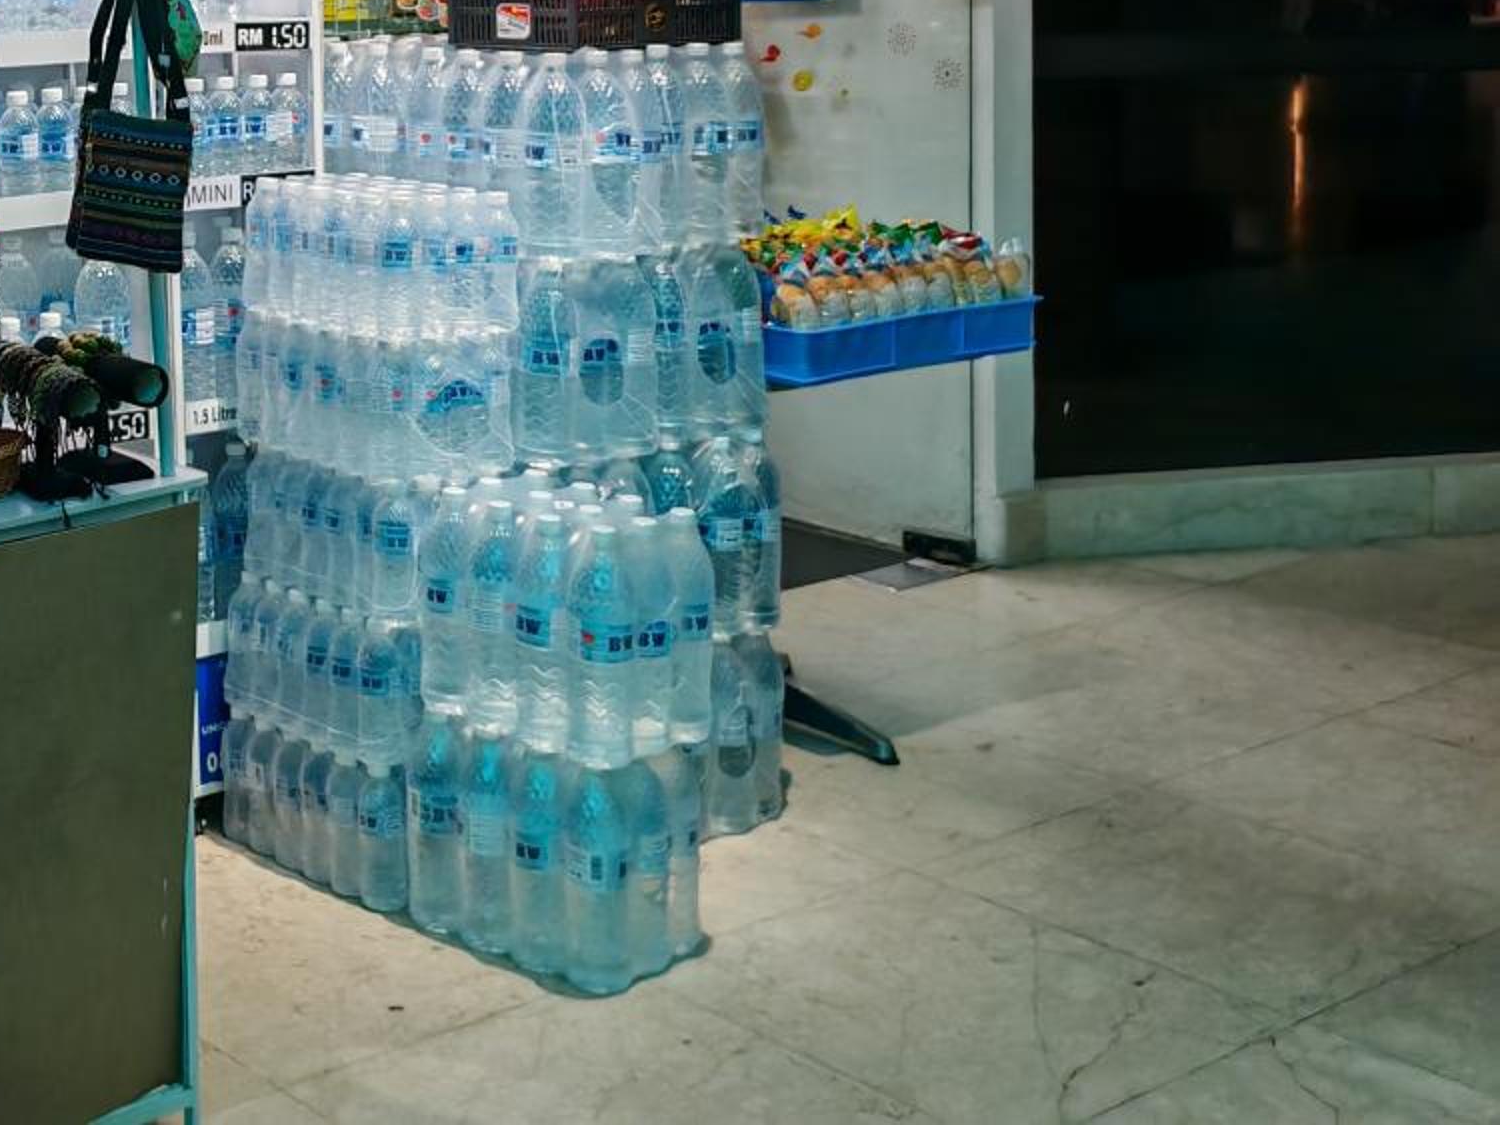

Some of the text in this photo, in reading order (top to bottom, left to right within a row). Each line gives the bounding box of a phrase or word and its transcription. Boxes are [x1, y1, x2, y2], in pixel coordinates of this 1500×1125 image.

[237, 23, 307, 49] RM 1.50
[191, 182, 233, 204] MINI
[243, 181, 254, 201] R
[193, 407, 209, 425] 1.5
[109, 412, 146, 443] .50
[515, 614, 542, 635] BW
[638, 632, 666, 648] BW
